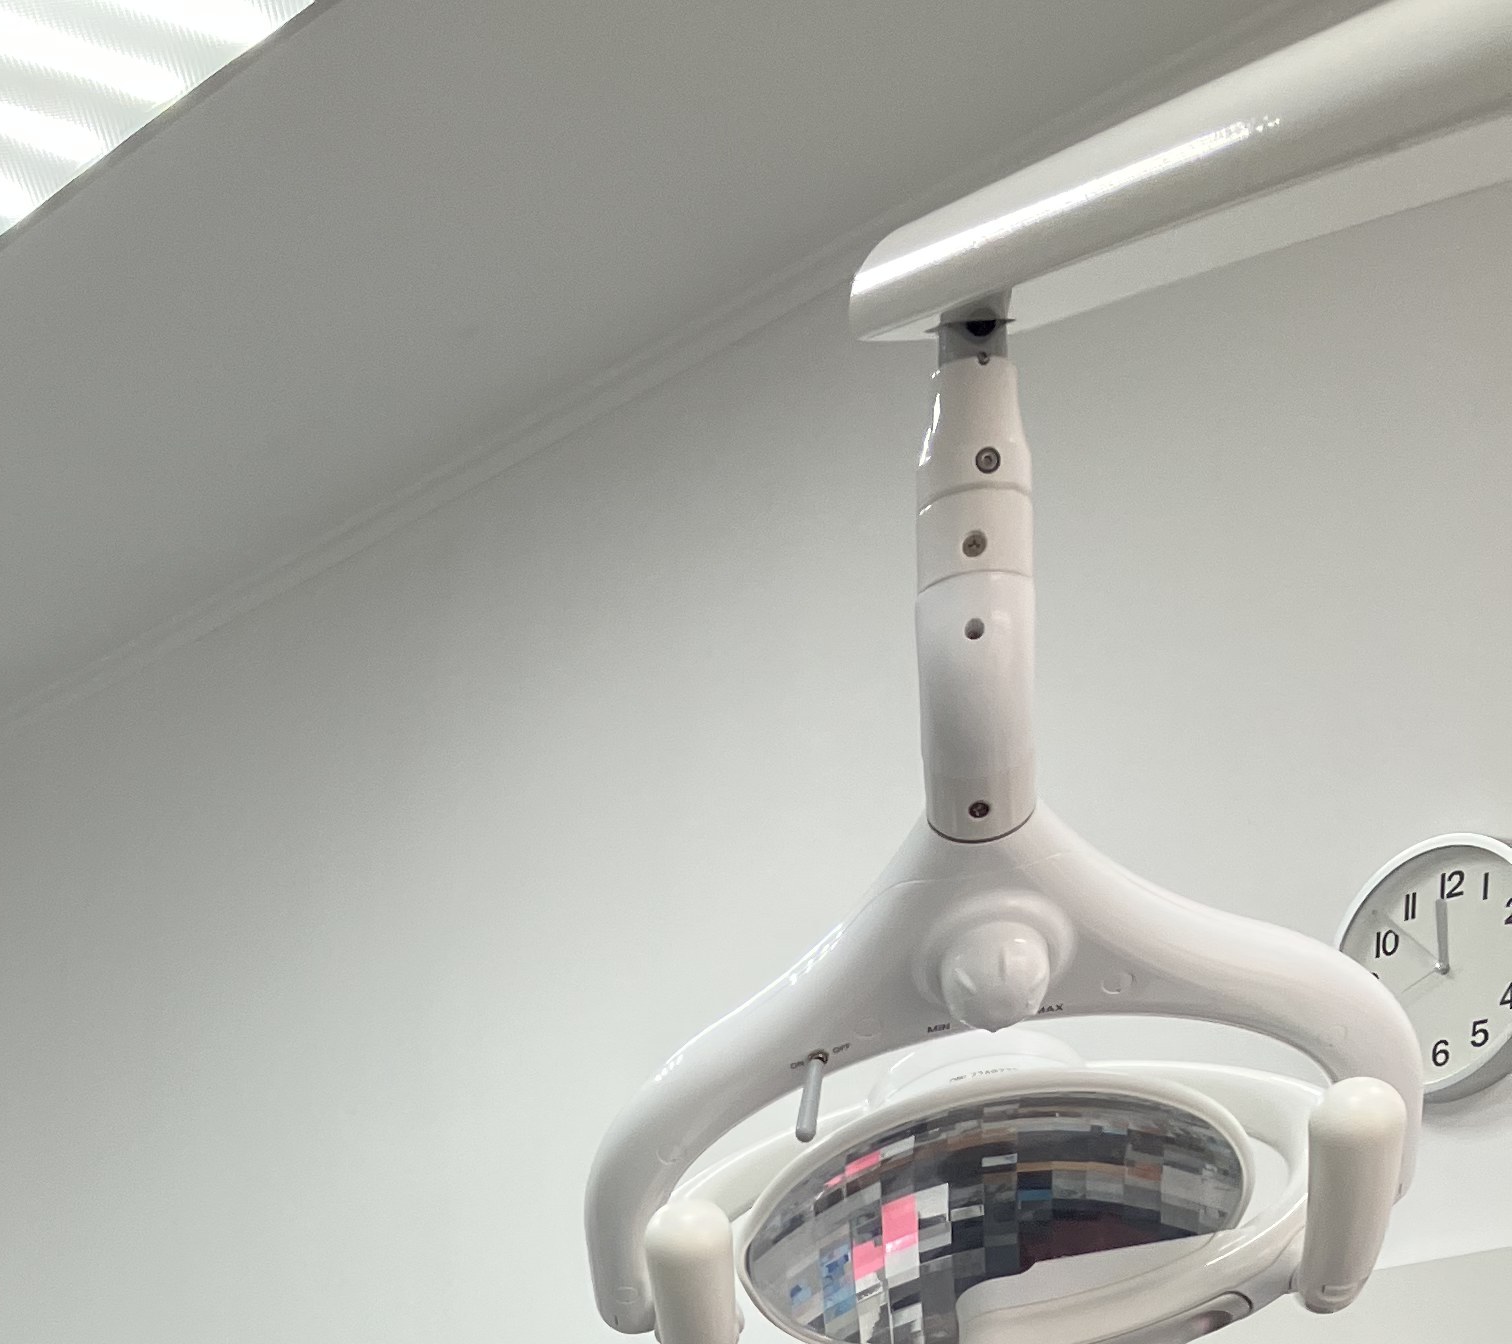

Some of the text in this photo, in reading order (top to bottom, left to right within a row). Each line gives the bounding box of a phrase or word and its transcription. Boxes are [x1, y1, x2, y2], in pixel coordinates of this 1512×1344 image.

[1440, 870, 1465, 900] 12
[1482, 871, 1490, 901] 1
[1403, 892, 1418, 922] 11
[1374, 929, 1400, 959] 10
[927, 1022, 951, 1034] MIN
[1470, 1019, 1490, 1048] 5
[1431, 1039, 1451, 1068] 6
